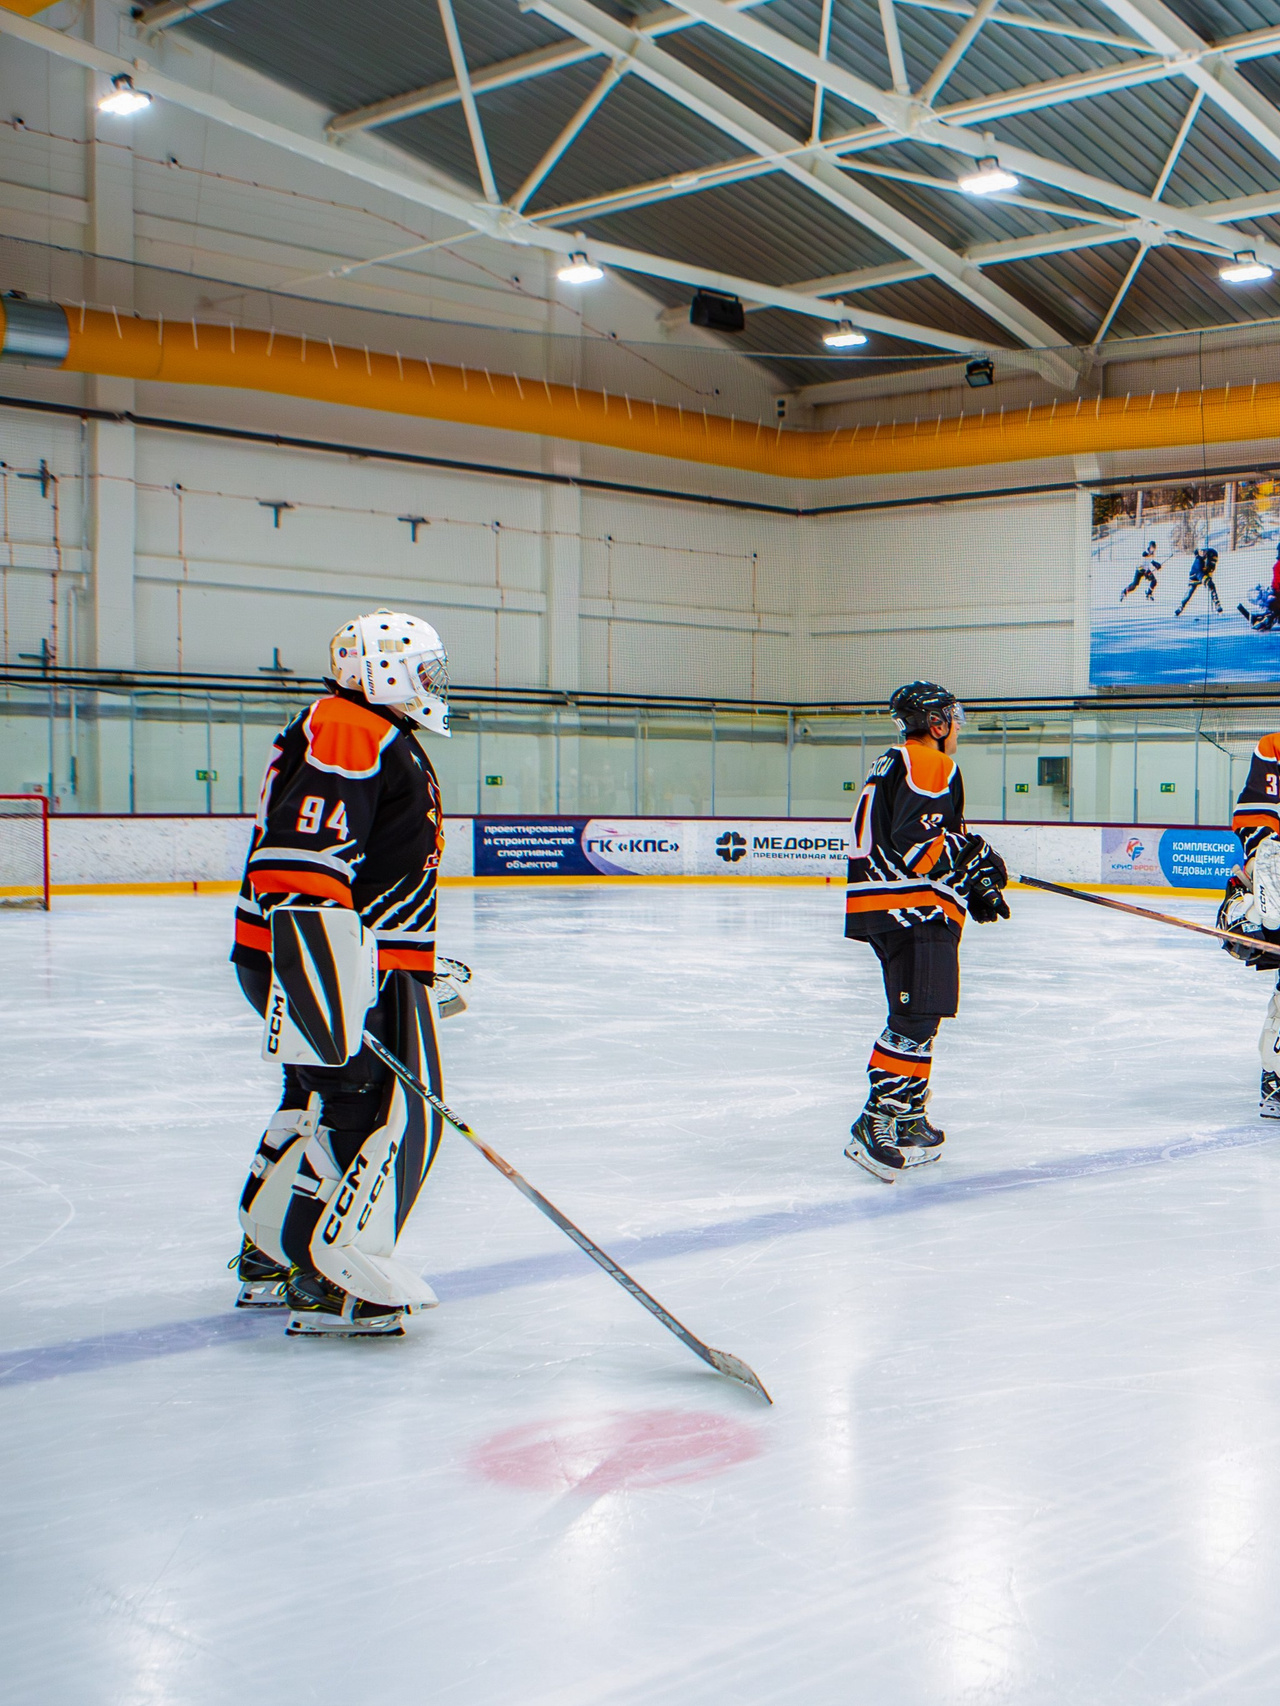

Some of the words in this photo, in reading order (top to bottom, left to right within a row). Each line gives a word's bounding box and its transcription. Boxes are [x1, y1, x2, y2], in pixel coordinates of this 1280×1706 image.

[296, 795, 350, 841] 94
[484, 825, 575, 836] проектирование
[493, 837, 575, 848] строительство
[587, 839, 613, 853] ГК
[617, 839, 680, 853] «КПС»
[1172, 842, 1236, 853] КОМПЛЕКСНОЕ
[497, 849, 565, 860] спортивных
[753, 852, 826, 860] ПРЕВЕНТИВНАЯ
[1172, 854, 1226, 865] ОСНАЩЕНИЕ
[506, 860, 558, 869] объектов
[1171, 866, 1213, 876] ЛЕДОВЫХ
[268, 995, 285, 1055] CCM
[428, 1094, 464, 1127] BAUER
[357, 1141, 398, 1231] CCM
[322, 1153, 369, 1245] CCM
